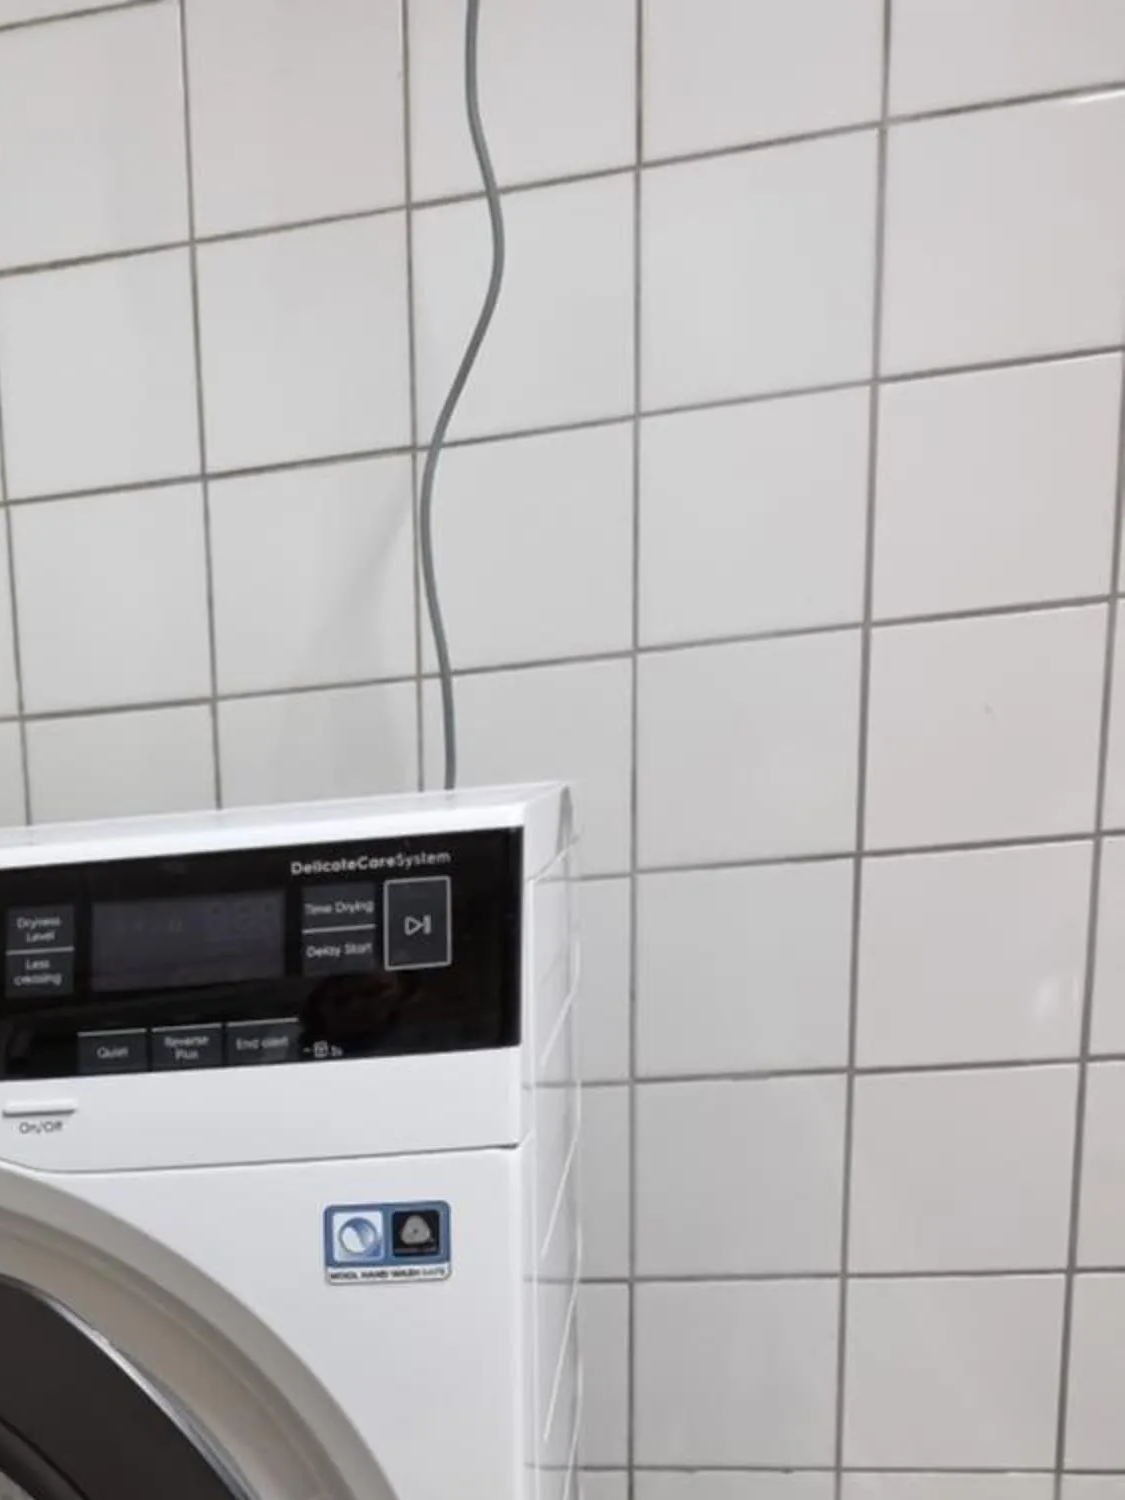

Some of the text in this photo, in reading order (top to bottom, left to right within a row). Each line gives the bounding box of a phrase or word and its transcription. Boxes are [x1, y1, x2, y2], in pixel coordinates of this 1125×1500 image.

[290, 852, 452, 875] DelicateCareSystem
[304, 900, 375, 915] Time Drying
[25, 930, 56, 943] Level
[305, 942, 373, 958] Delay Start
[25, 958, 51, 970] Less
[96, 1045, 130, 1060] Quiet
[174, 1048, 200, 1061] Plus
[18, 1120, 63, 1135] On/Off
